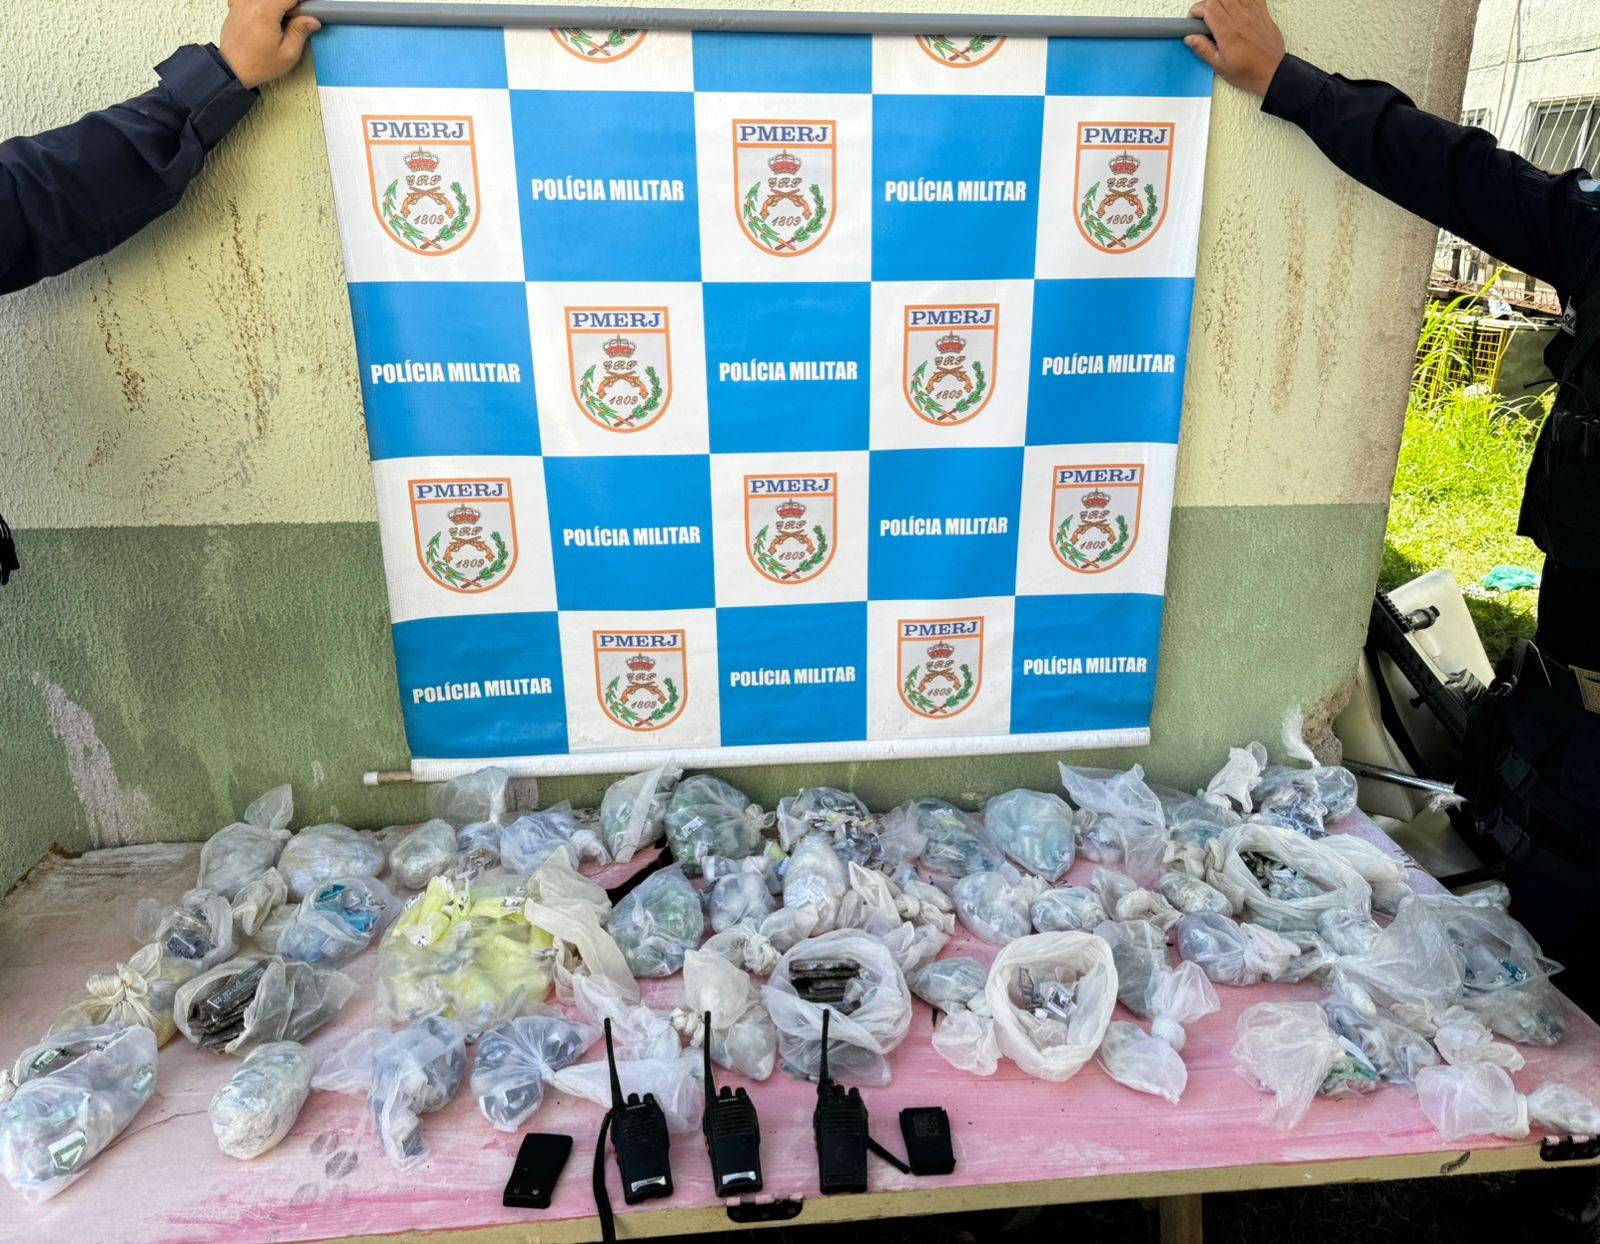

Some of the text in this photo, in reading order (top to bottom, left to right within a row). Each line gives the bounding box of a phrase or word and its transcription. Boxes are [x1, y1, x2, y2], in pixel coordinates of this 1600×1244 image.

[372, 122, 464, 139] PMERJ
[741, 125, 829, 142] PMERJ
[1084, 128, 1166, 144] PMERJ
[532, 176, 684, 201] POLÍCIA MILITAR
[885, 177, 1026, 202] POLÍCIA MILITAR
[412, 212, 445, 226] 1809
[770, 213, 801, 227] 1809
[1106, 213, 1134, 225] 1809
[572, 312, 660, 328] PMERJ
[912, 309, 992, 326] PMERJ
[371, 360, 520, 384] POLÍCIA MILITAR
[720, 359, 857, 382] POLÍCIA MILITAR
[1043, 353, 1175, 375] POLÍCIA MILITAR
[608, 393, 639, 406] 1809
[935, 389, 963, 401] 1809
[1059, 468, 1137, 484] PMERJ
[417, 483, 504, 499] PMERJ
[751, 478, 831, 493] PMERJ
[881, 516, 1008, 536] POLÍCIA MILITAR
[564, 526, 700, 546] POLÍCIA MILITAR
[1079, 540, 1107, 551] 1809
[455, 558, 485, 569] 1809
[777, 550, 805, 561] 1809
[904, 622, 977, 637] PMERJ
[601, 635, 678, 648] PMERJ
[1024, 656, 1147, 675] POLÍCIA MILITAR
[731, 667, 855, 687] POLÍCIA MILITAR
[413, 678, 552, 703] POLÍCIA MILITAR
[927, 687, 953, 697] 1809
[630, 699, 657, 709] 1809
